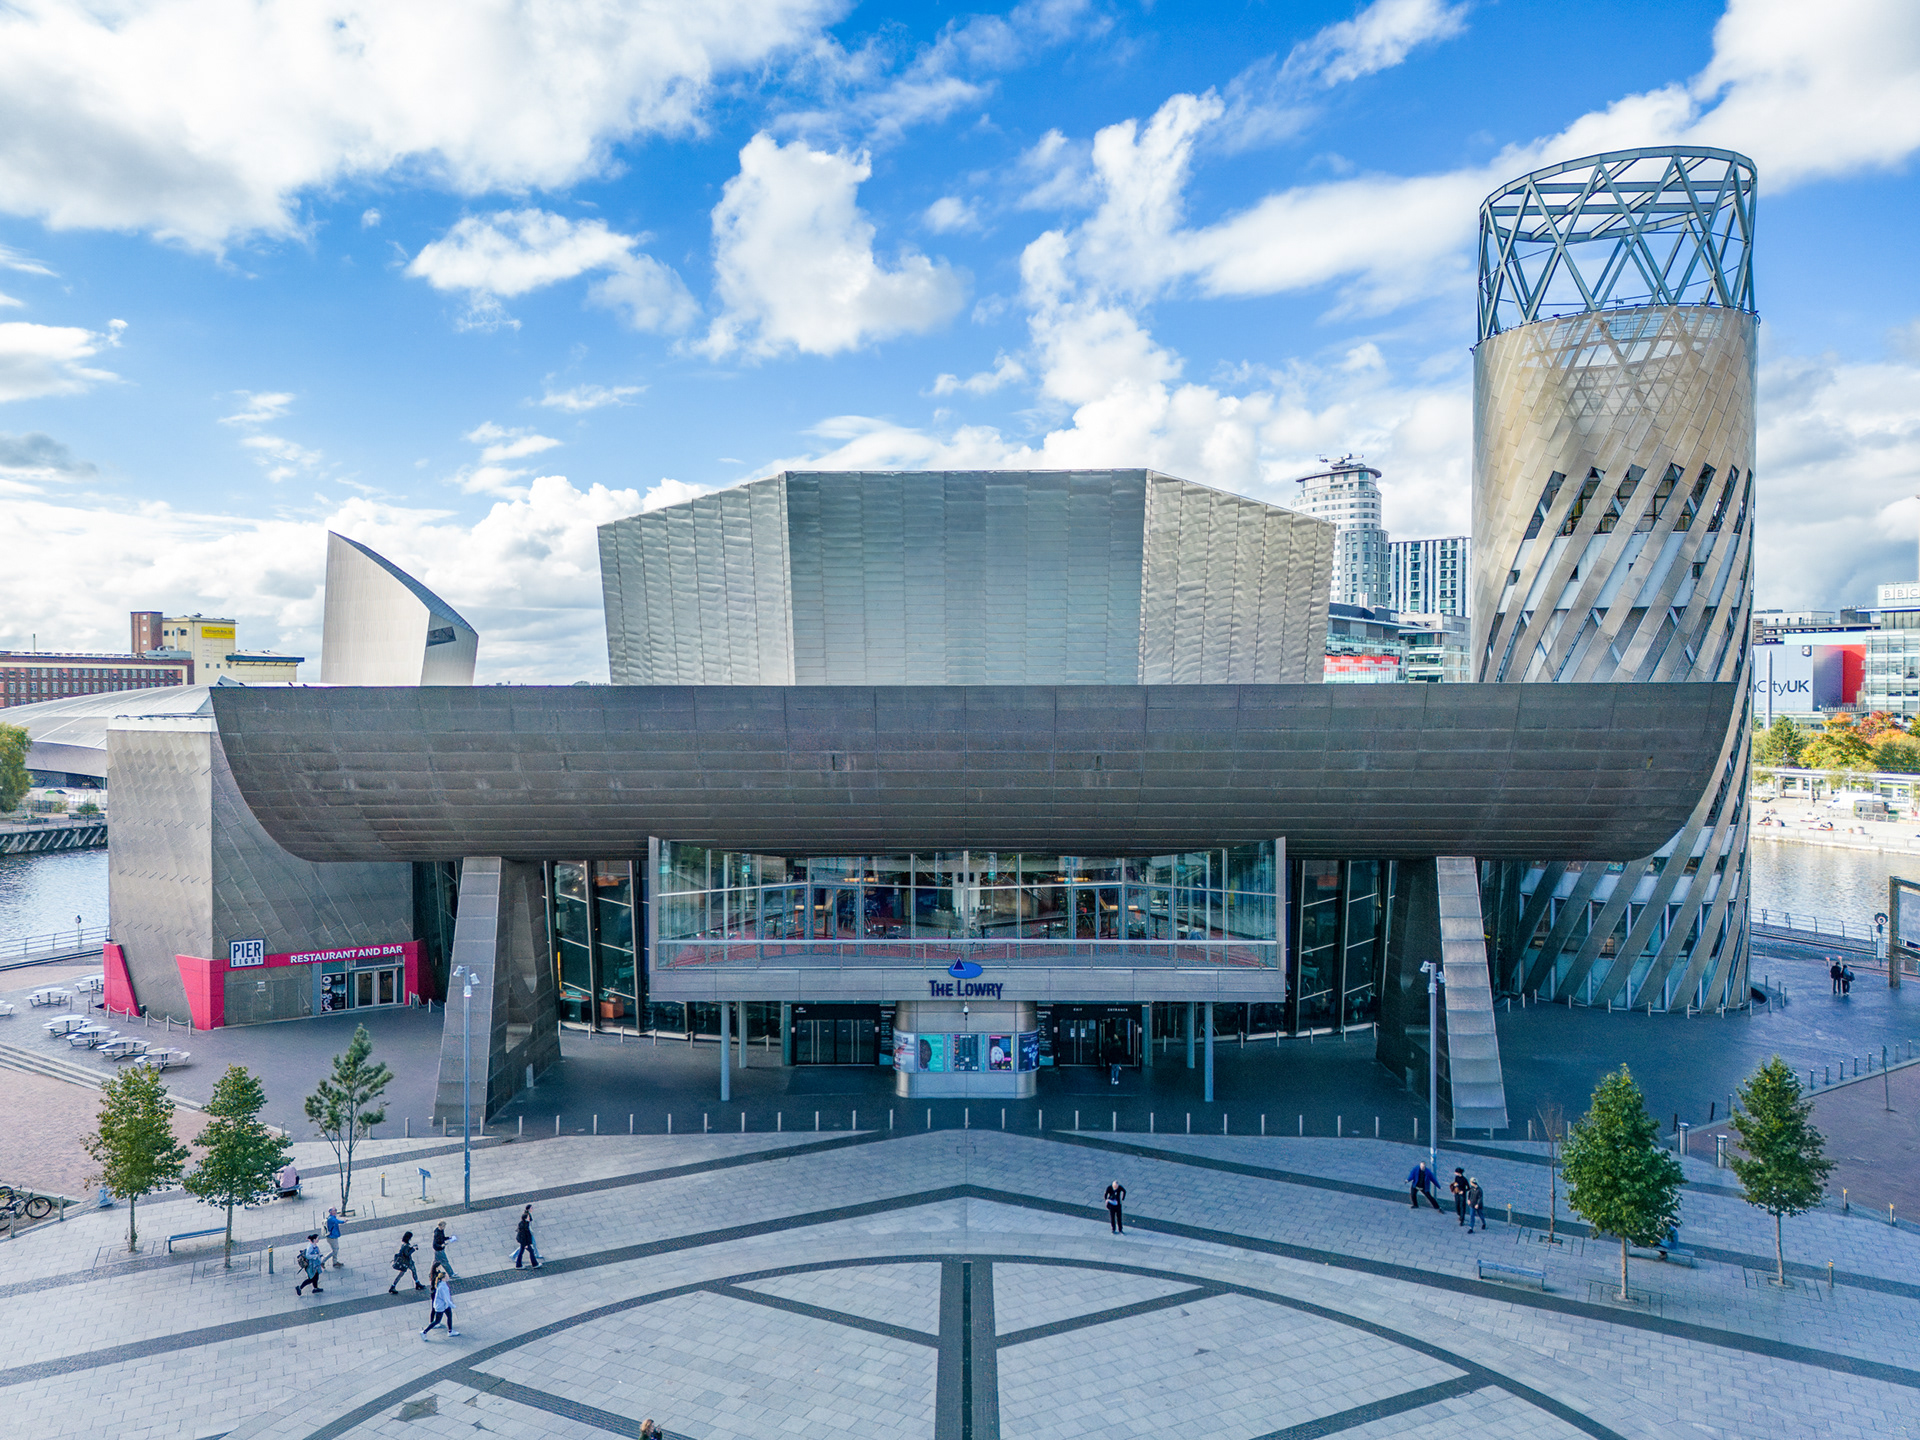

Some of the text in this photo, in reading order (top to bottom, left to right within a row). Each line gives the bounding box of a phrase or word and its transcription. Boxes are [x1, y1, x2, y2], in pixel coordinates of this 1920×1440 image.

[1884, 588, 1919, 598] BBC
[233, 942, 261, 959] PIER
[290, 945, 403, 963] RESTAURANT AND BAR
[233, 957, 261, 966] EIGHT
[929, 980, 1003, 1000] THE LOWRY
